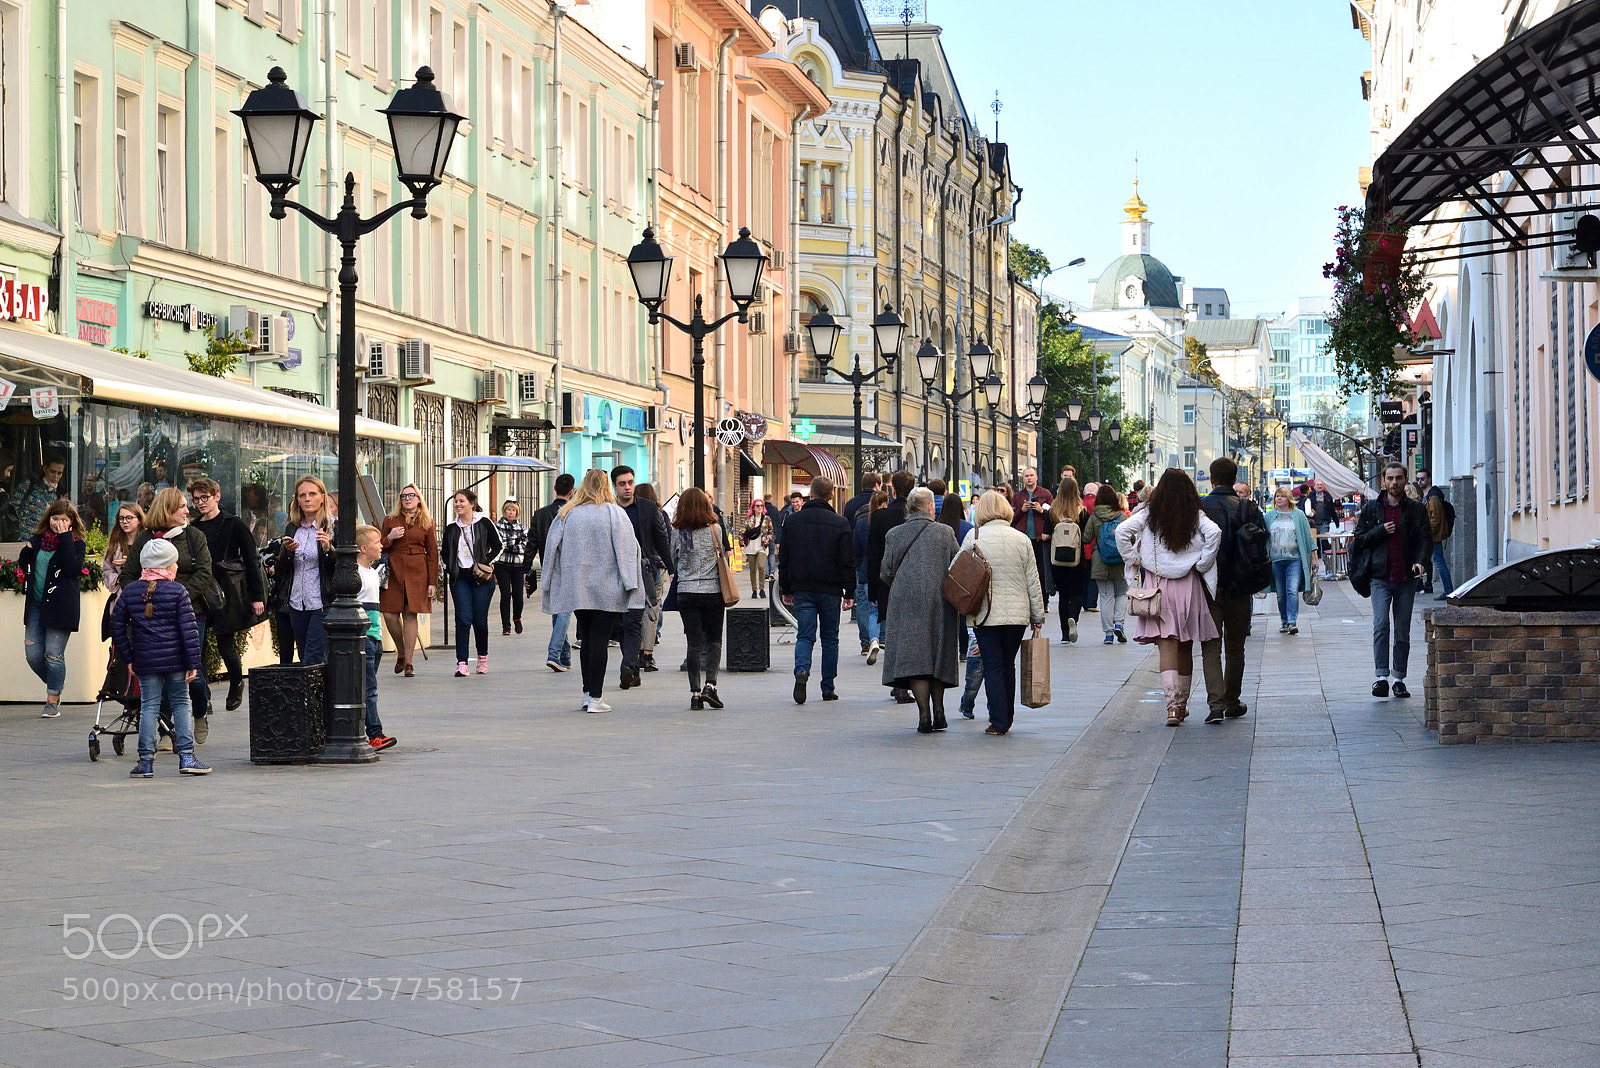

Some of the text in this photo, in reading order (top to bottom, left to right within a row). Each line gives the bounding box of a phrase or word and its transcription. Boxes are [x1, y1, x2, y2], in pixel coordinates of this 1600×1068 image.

[13, 279, 49, 327] БАР
[149, 301, 218, 330] СЕРВИСНЫЙ ЦЕНТР
